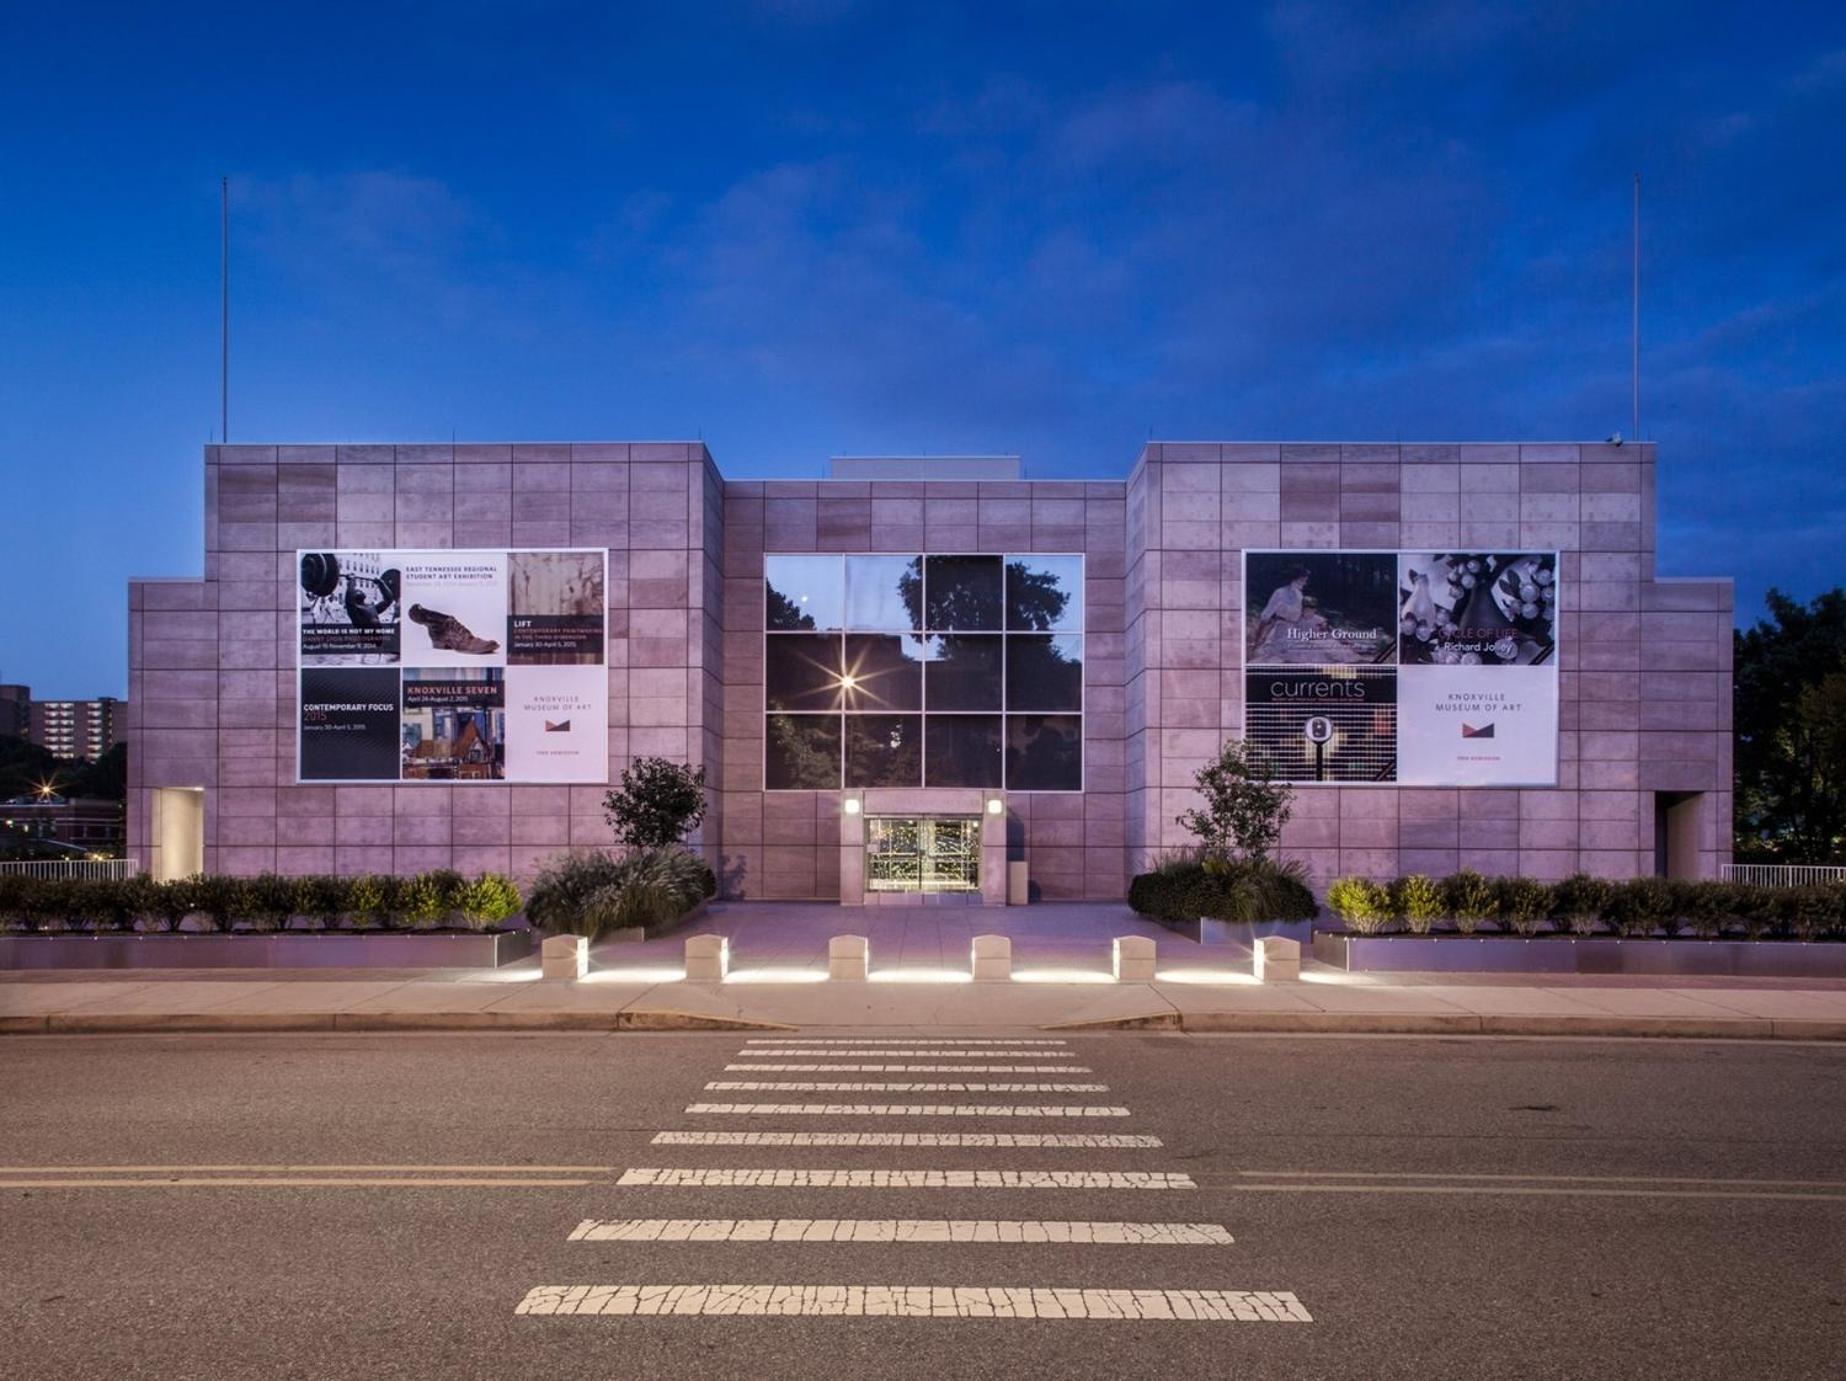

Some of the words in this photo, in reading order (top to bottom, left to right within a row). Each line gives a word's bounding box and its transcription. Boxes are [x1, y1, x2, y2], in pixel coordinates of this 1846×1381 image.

[513, 620, 532, 628] LIFT
[1287, 628, 1327, 641] Higher
[1331, 628, 1377, 639] Ground
[1444, 641, 1481, 651] Richard
[407, 686, 462, 694] KNOXVILLE
[464, 686, 498, 694] SEVEN
[1270, 681, 1366, 698] currents
[1448, 693, 1505, 702] KNOXVILLE
[303, 703, 367, 712] CONTEMPORARY
[368, 703, 394, 712] FOCUS
[524, 703, 560, 712] MUSEUM
[562, 703, 573, 711] OF
[576, 703, 592, 711] ART
[1435, 703, 1480, 712] MUSEUM
[1484, 703, 1497, 712] OF
[1502, 703, 1522, 712] ART
[303, 712, 328, 721] 2015
